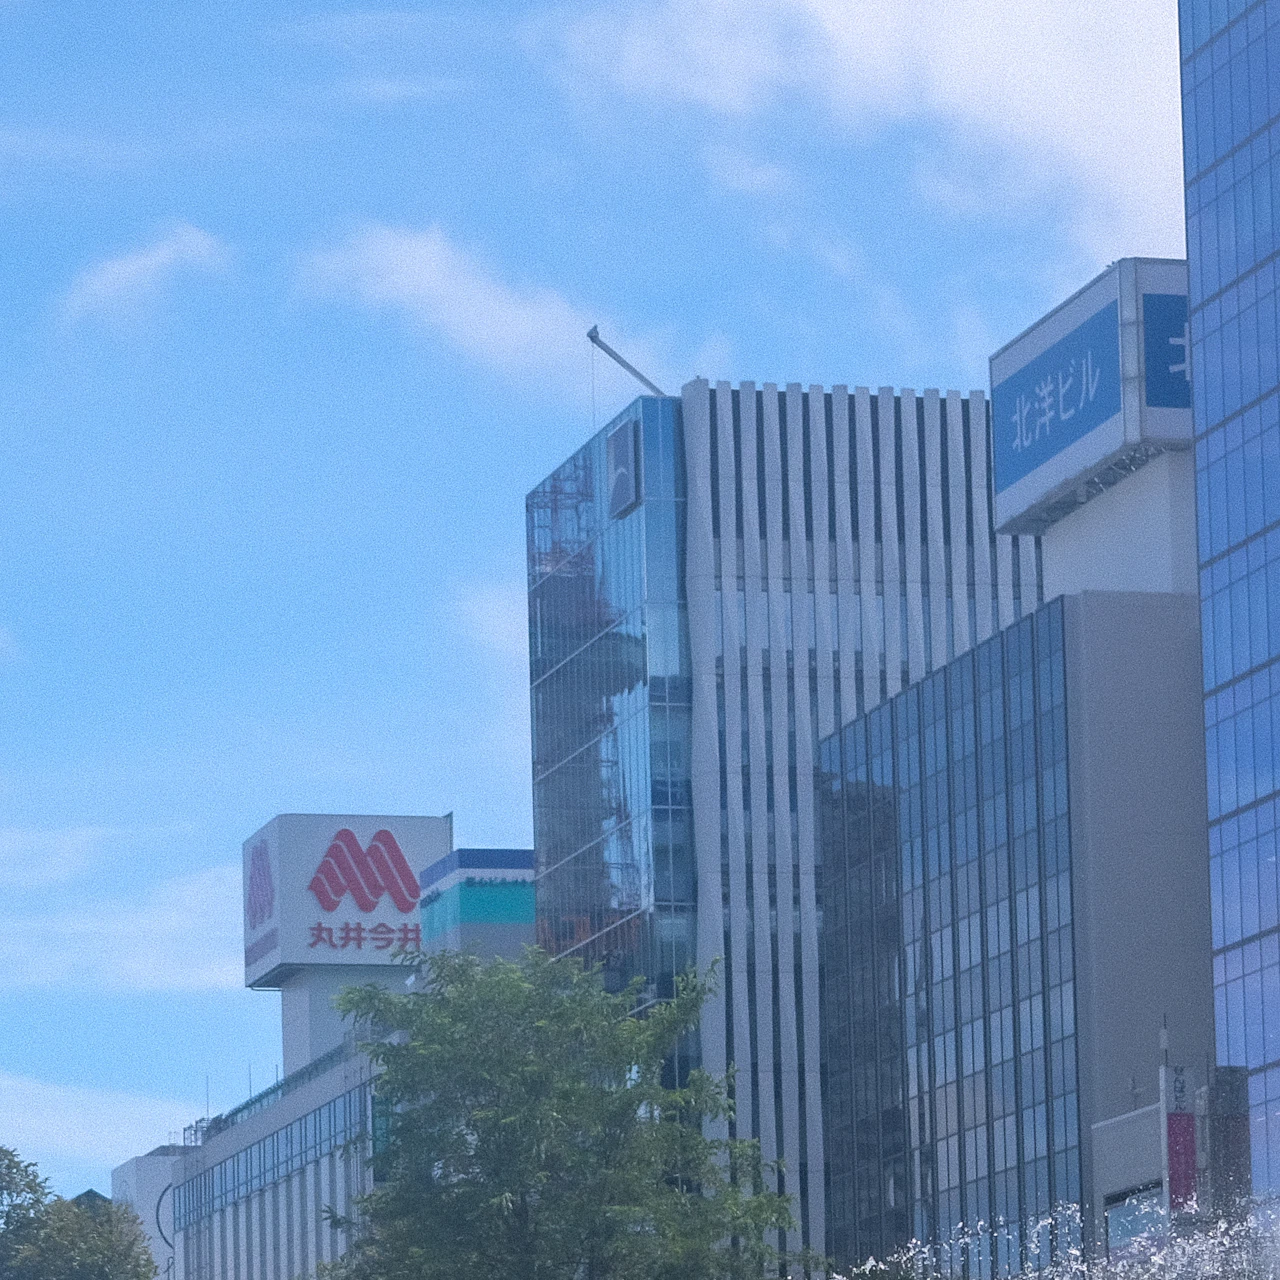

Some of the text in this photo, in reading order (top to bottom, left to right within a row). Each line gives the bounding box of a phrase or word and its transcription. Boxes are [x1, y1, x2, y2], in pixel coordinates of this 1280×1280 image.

[1012, 351, 1100, 452] 北洋ビル
[309, 922, 421, 950] 丸井今井
